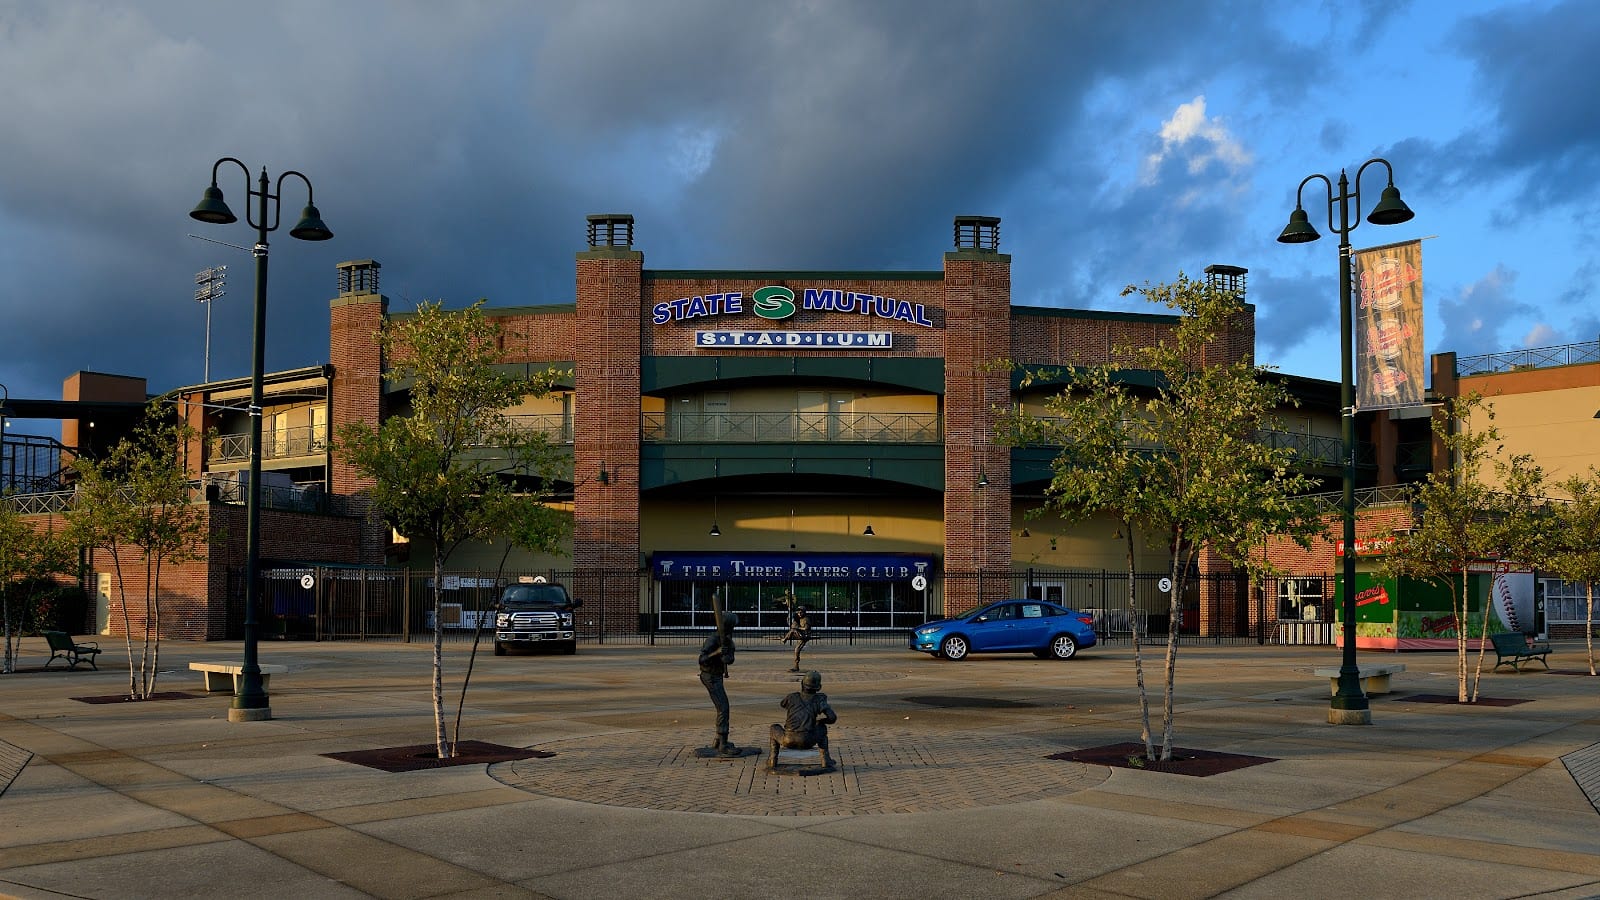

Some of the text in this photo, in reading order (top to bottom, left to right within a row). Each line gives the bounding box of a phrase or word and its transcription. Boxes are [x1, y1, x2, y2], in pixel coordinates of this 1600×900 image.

[652, 292, 743, 325] STATE
[803, 288, 933, 328] MUTUAL
[682, 560, 909, 578] THE THREE RIVERS CLUB
[915, 578, 924, 589] 4
